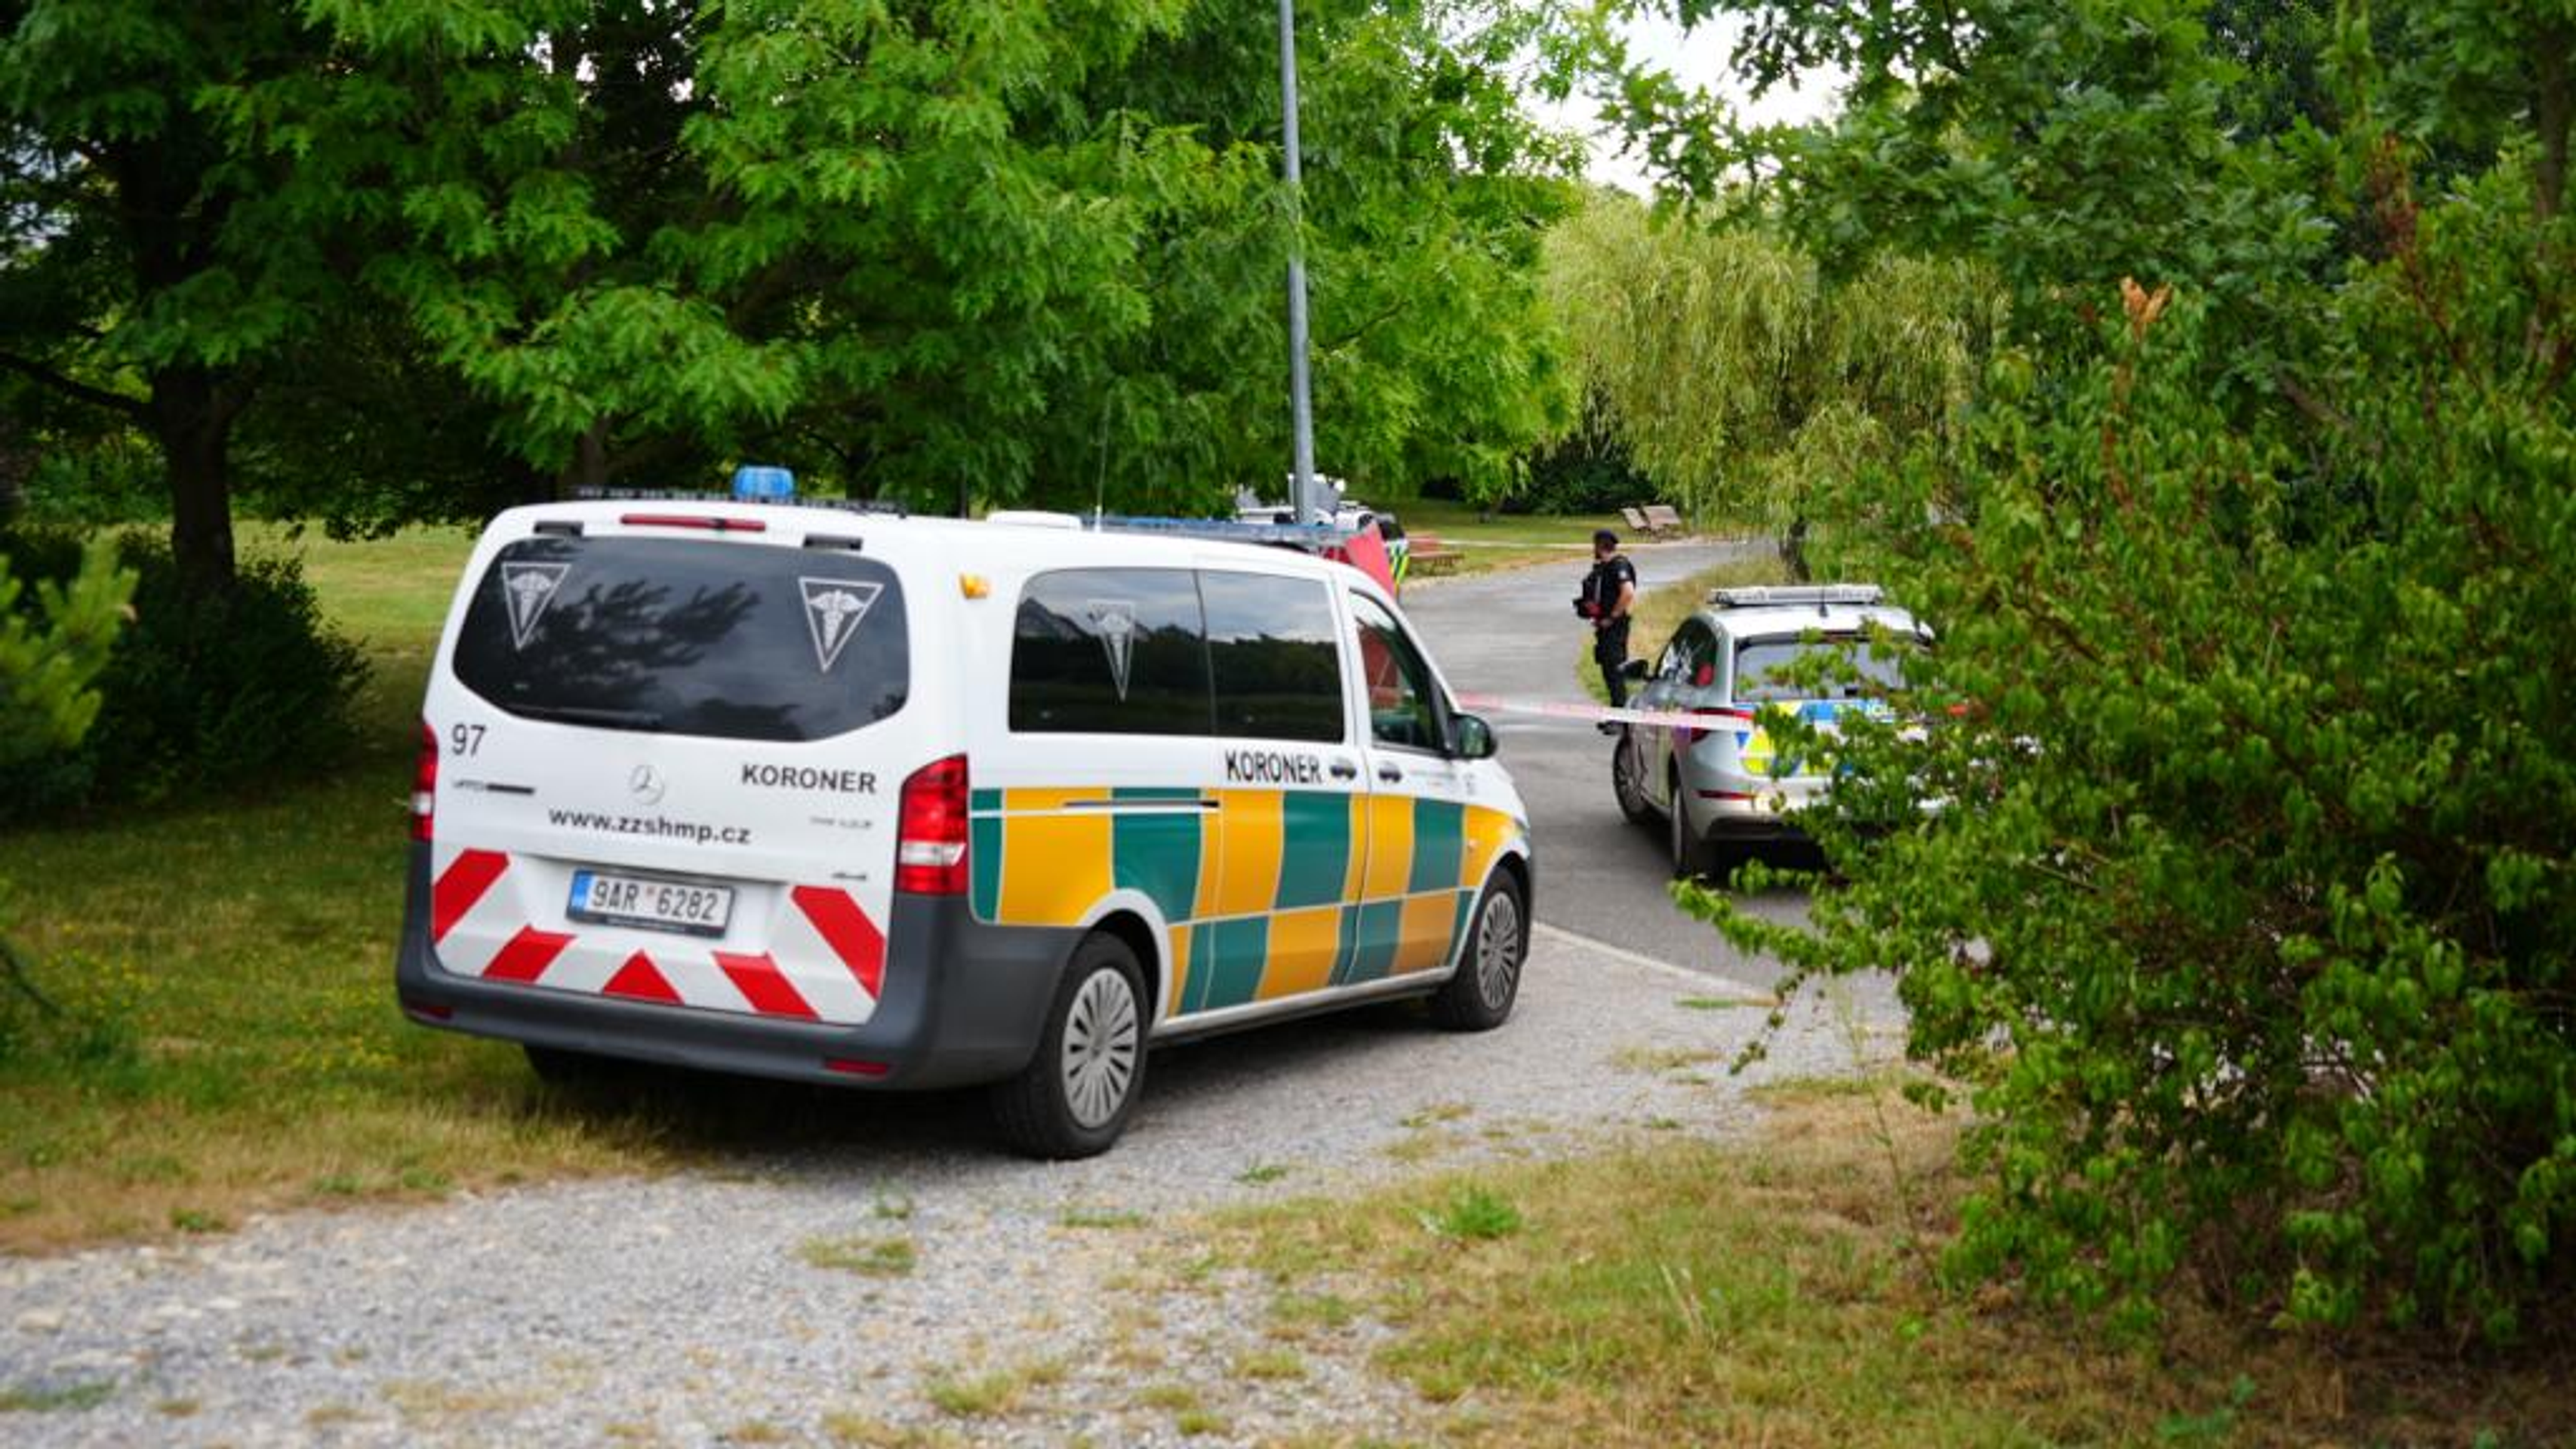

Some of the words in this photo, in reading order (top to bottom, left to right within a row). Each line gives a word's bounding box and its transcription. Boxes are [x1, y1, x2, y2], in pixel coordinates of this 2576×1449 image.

[453, 724, 486, 755] 97
[742, 764, 876, 793] KORONER
[1225, 751, 1322, 783] KORONER
[549, 808, 750, 844] www.zzshmp.cz
[592, 880, 640, 912] 9AR
[656, 887, 719, 920] 6282
